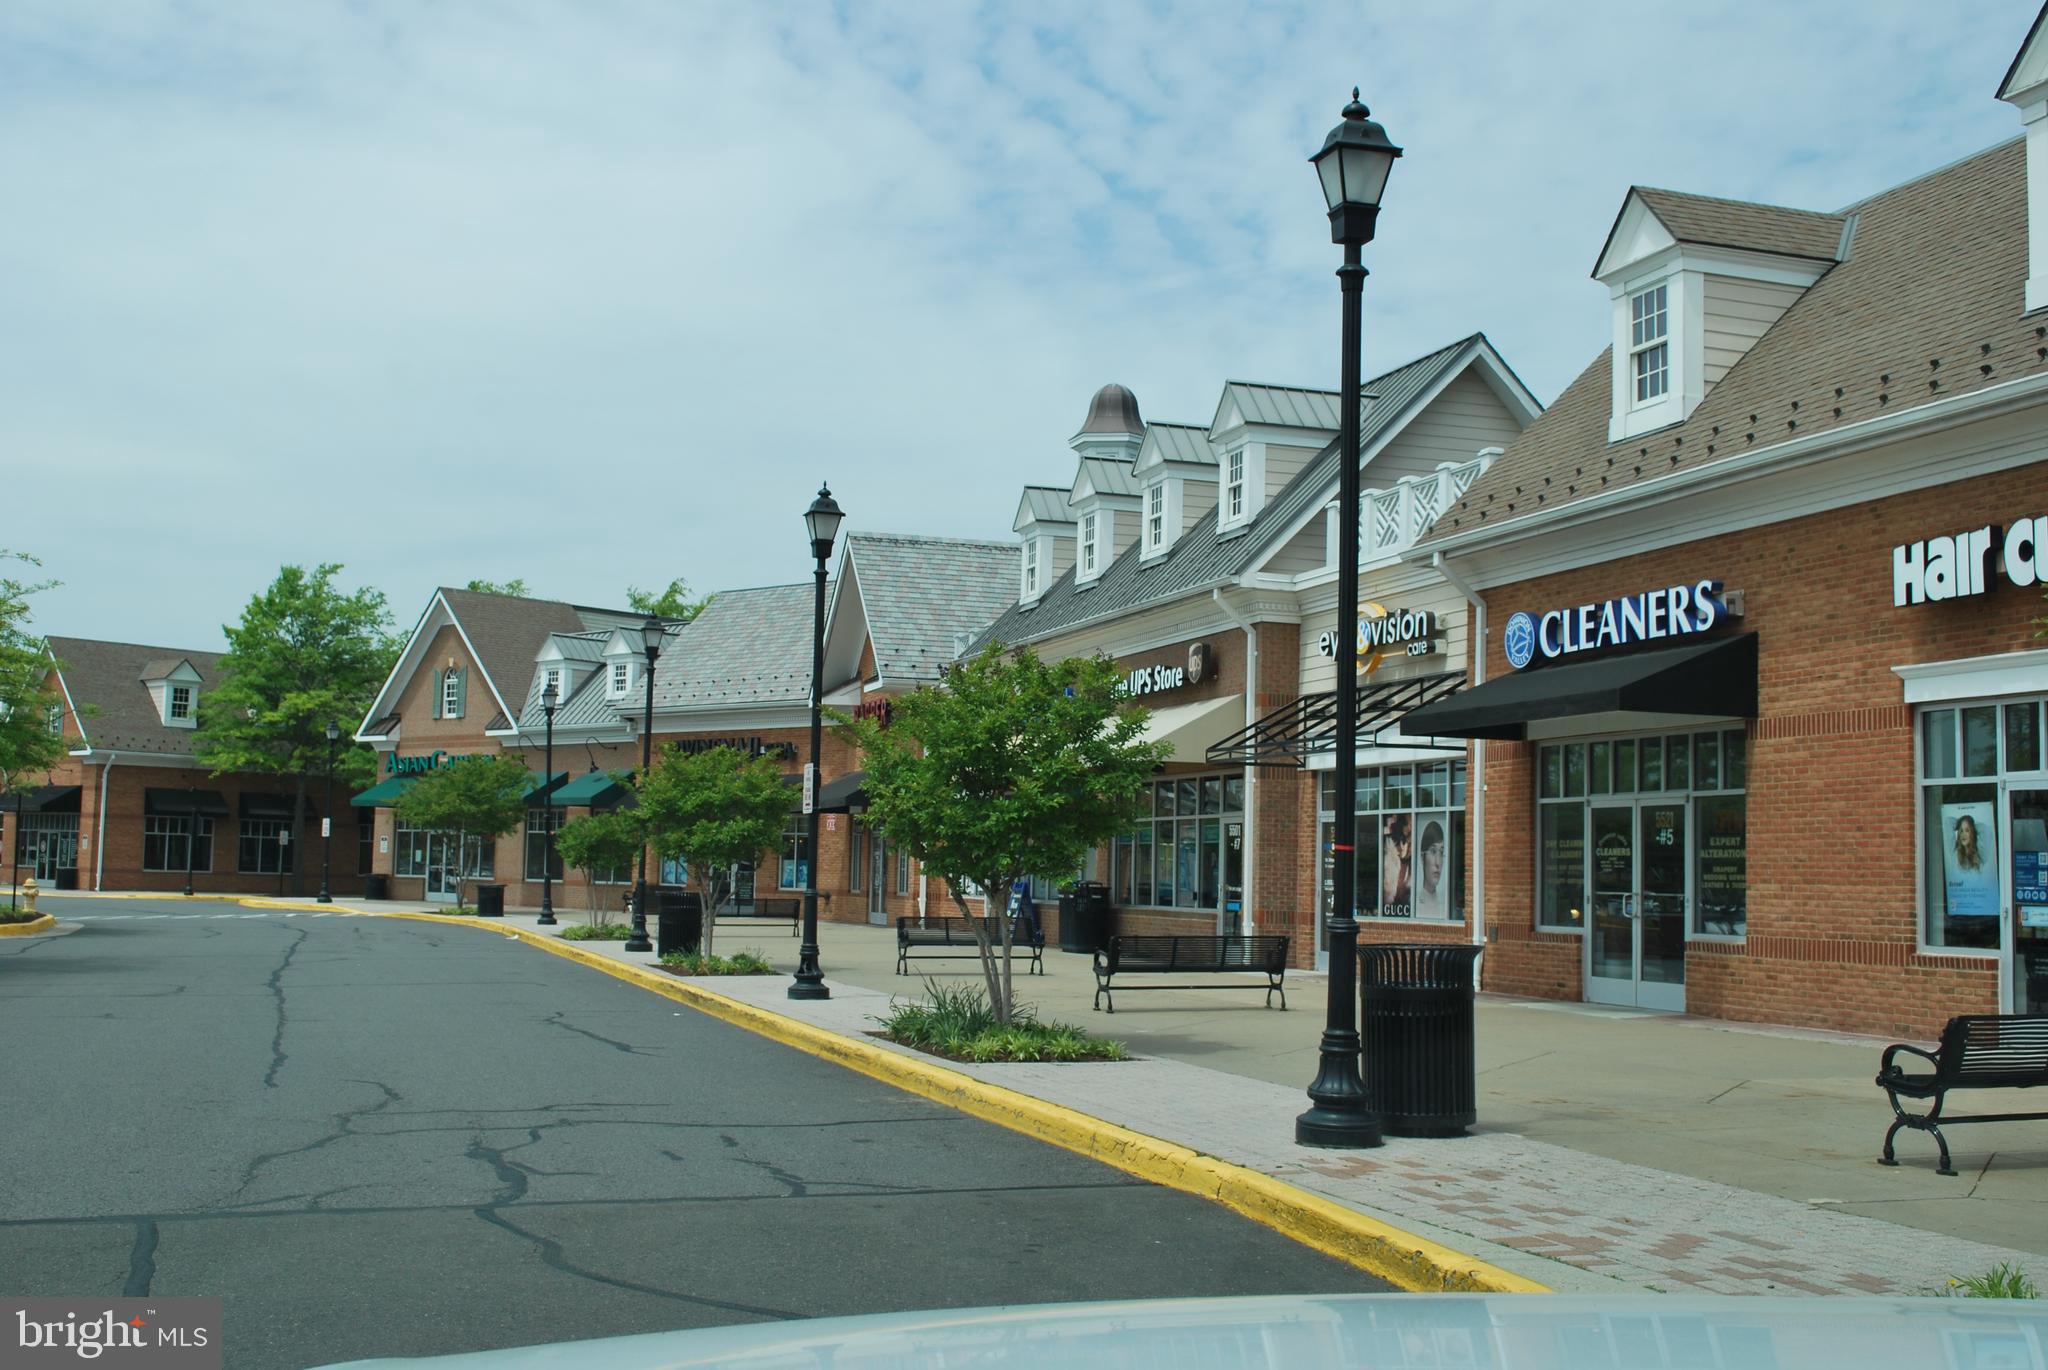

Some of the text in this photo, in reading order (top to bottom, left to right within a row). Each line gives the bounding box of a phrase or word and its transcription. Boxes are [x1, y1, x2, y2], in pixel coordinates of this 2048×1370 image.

[1893, 525, 1991, 607] Hair
[1539, 579, 1716, 658] CLEANERS
[1319, 631, 1339, 662] ey
[1371, 608, 1427, 646] vision
[1407, 640, 1428, 657] care
[1189, 654, 1201, 672] ups
[1511, 653, 1530, 665] VALLEY
[1130, 667, 1152, 697] UPS
[1153, 664, 1183, 693] Store
[384, 751, 431, 774] ASIAN
[1709, 836, 1741, 847] EXPERT
[1595, 847, 1632, 857] CLEANERS
